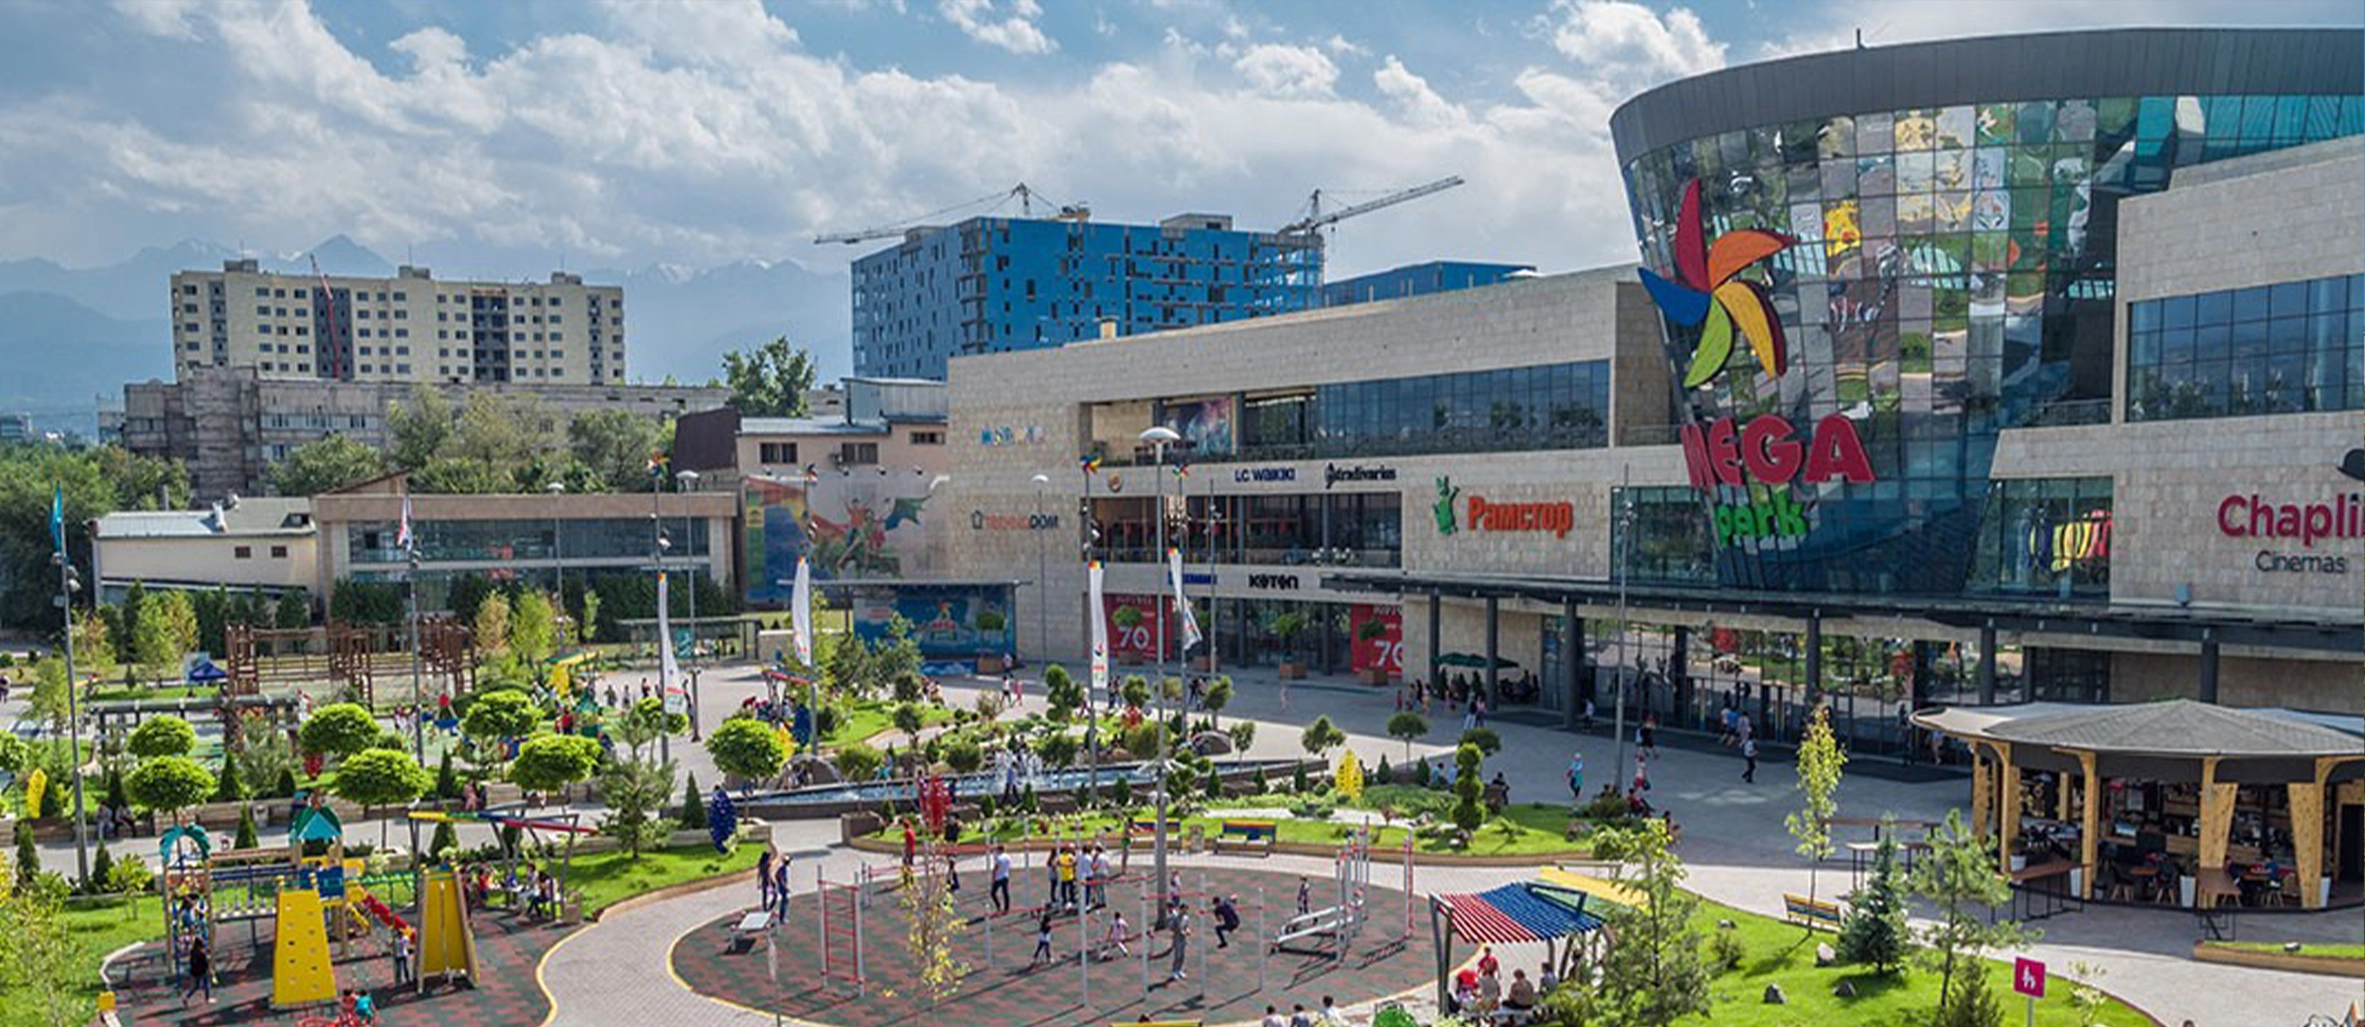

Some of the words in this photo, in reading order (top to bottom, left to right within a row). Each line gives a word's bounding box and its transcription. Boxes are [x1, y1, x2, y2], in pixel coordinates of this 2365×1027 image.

[1680, 413, 1876, 488] MEGA
[1234, 469, 1249, 482] LC
[1467, 496, 1574, 539] Рамстор
[1716, 489, 1808, 549] park
[2217, 493, 2365, 547] Chapli
[2255, 550, 2348, 574] Cinemas
[1118, 626, 1150, 650] 70
